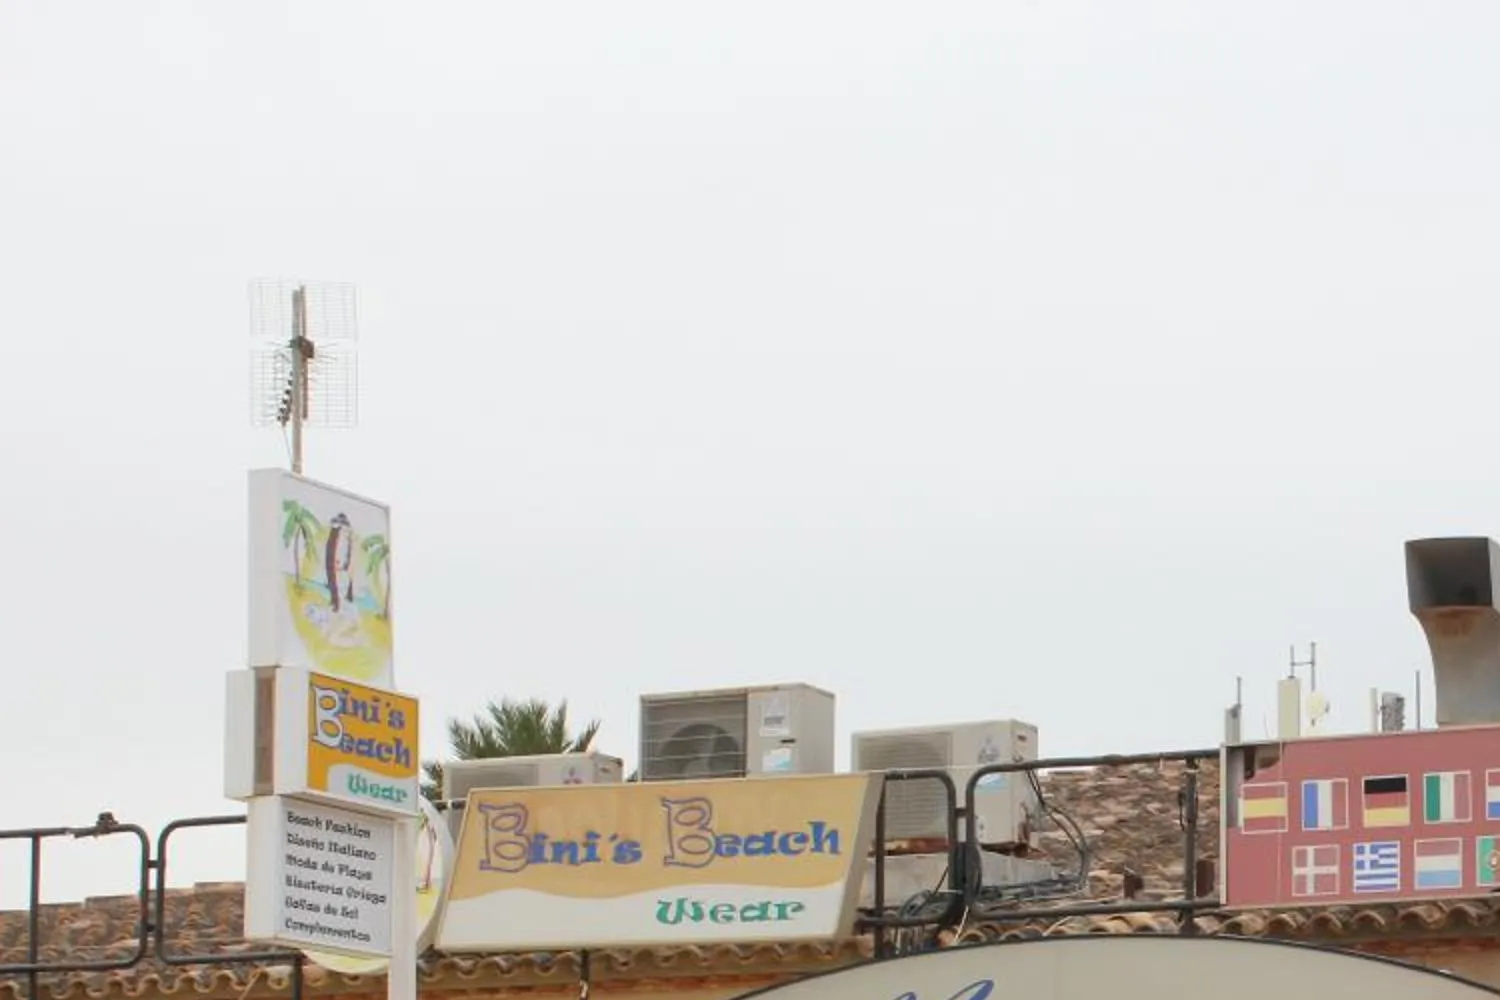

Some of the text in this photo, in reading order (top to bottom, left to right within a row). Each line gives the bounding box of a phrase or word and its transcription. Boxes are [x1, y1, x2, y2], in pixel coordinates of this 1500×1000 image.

[347, 772, 408, 803] Wear
[287, 811, 371, 839] Beach Fashion
[478, 796, 842, 873] Bini's Beach
[327, 841, 377, 861] Italiano
[655, 897, 806, 926] Wear
[285, 917, 371, 943] Complementos
